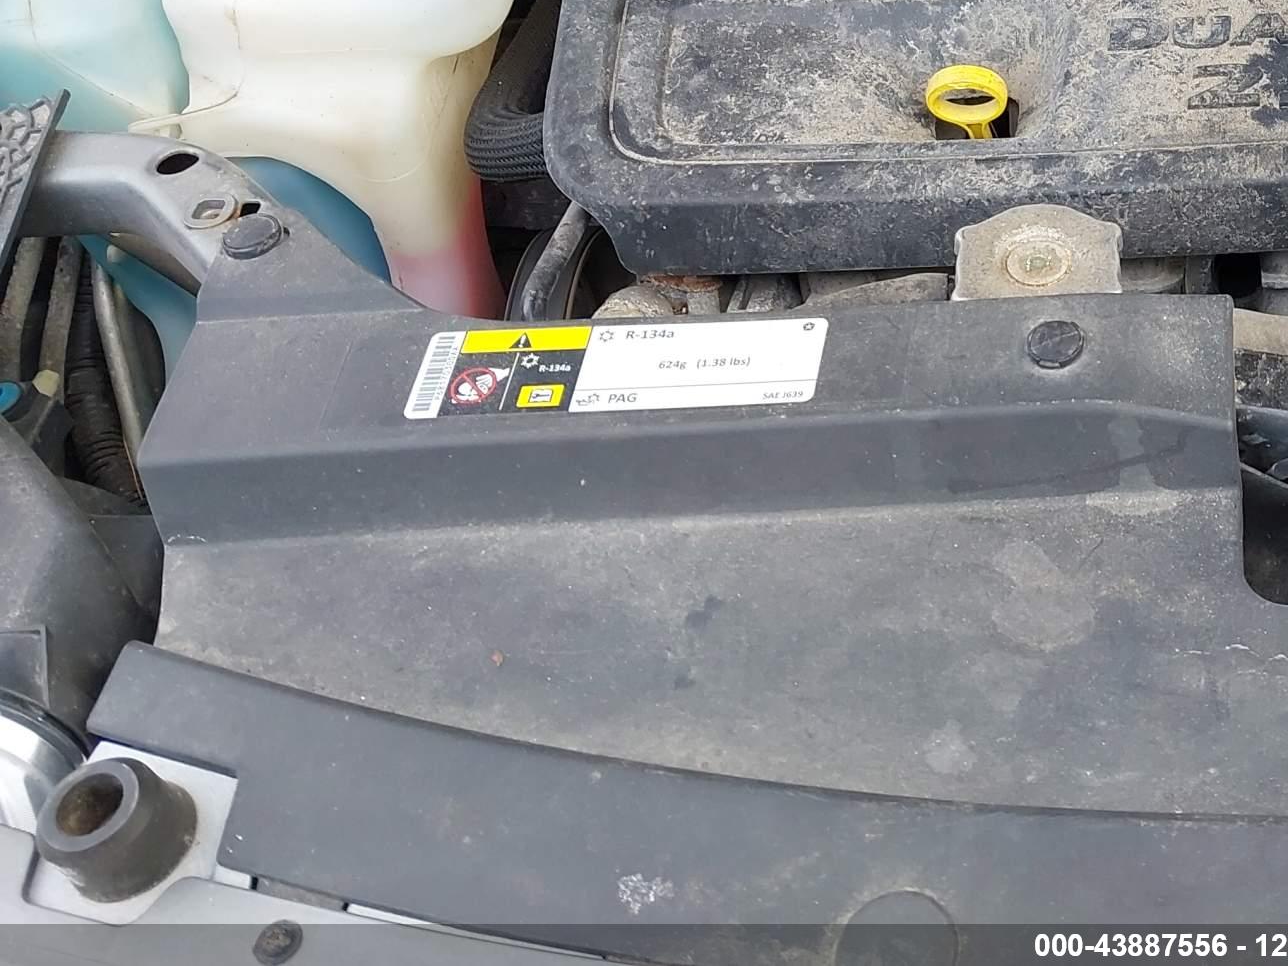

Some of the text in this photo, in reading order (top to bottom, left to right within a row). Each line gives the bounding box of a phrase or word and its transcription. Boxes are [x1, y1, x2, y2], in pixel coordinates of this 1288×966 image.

[625, 329, 675, 340] R-134a
[538, 361, 571, 374] R-134a
[658, 356, 751, 371] 624g (1.38 lbs)
[608, 392, 638, 404] PAG
[762, 392, 780, 401] SAE
